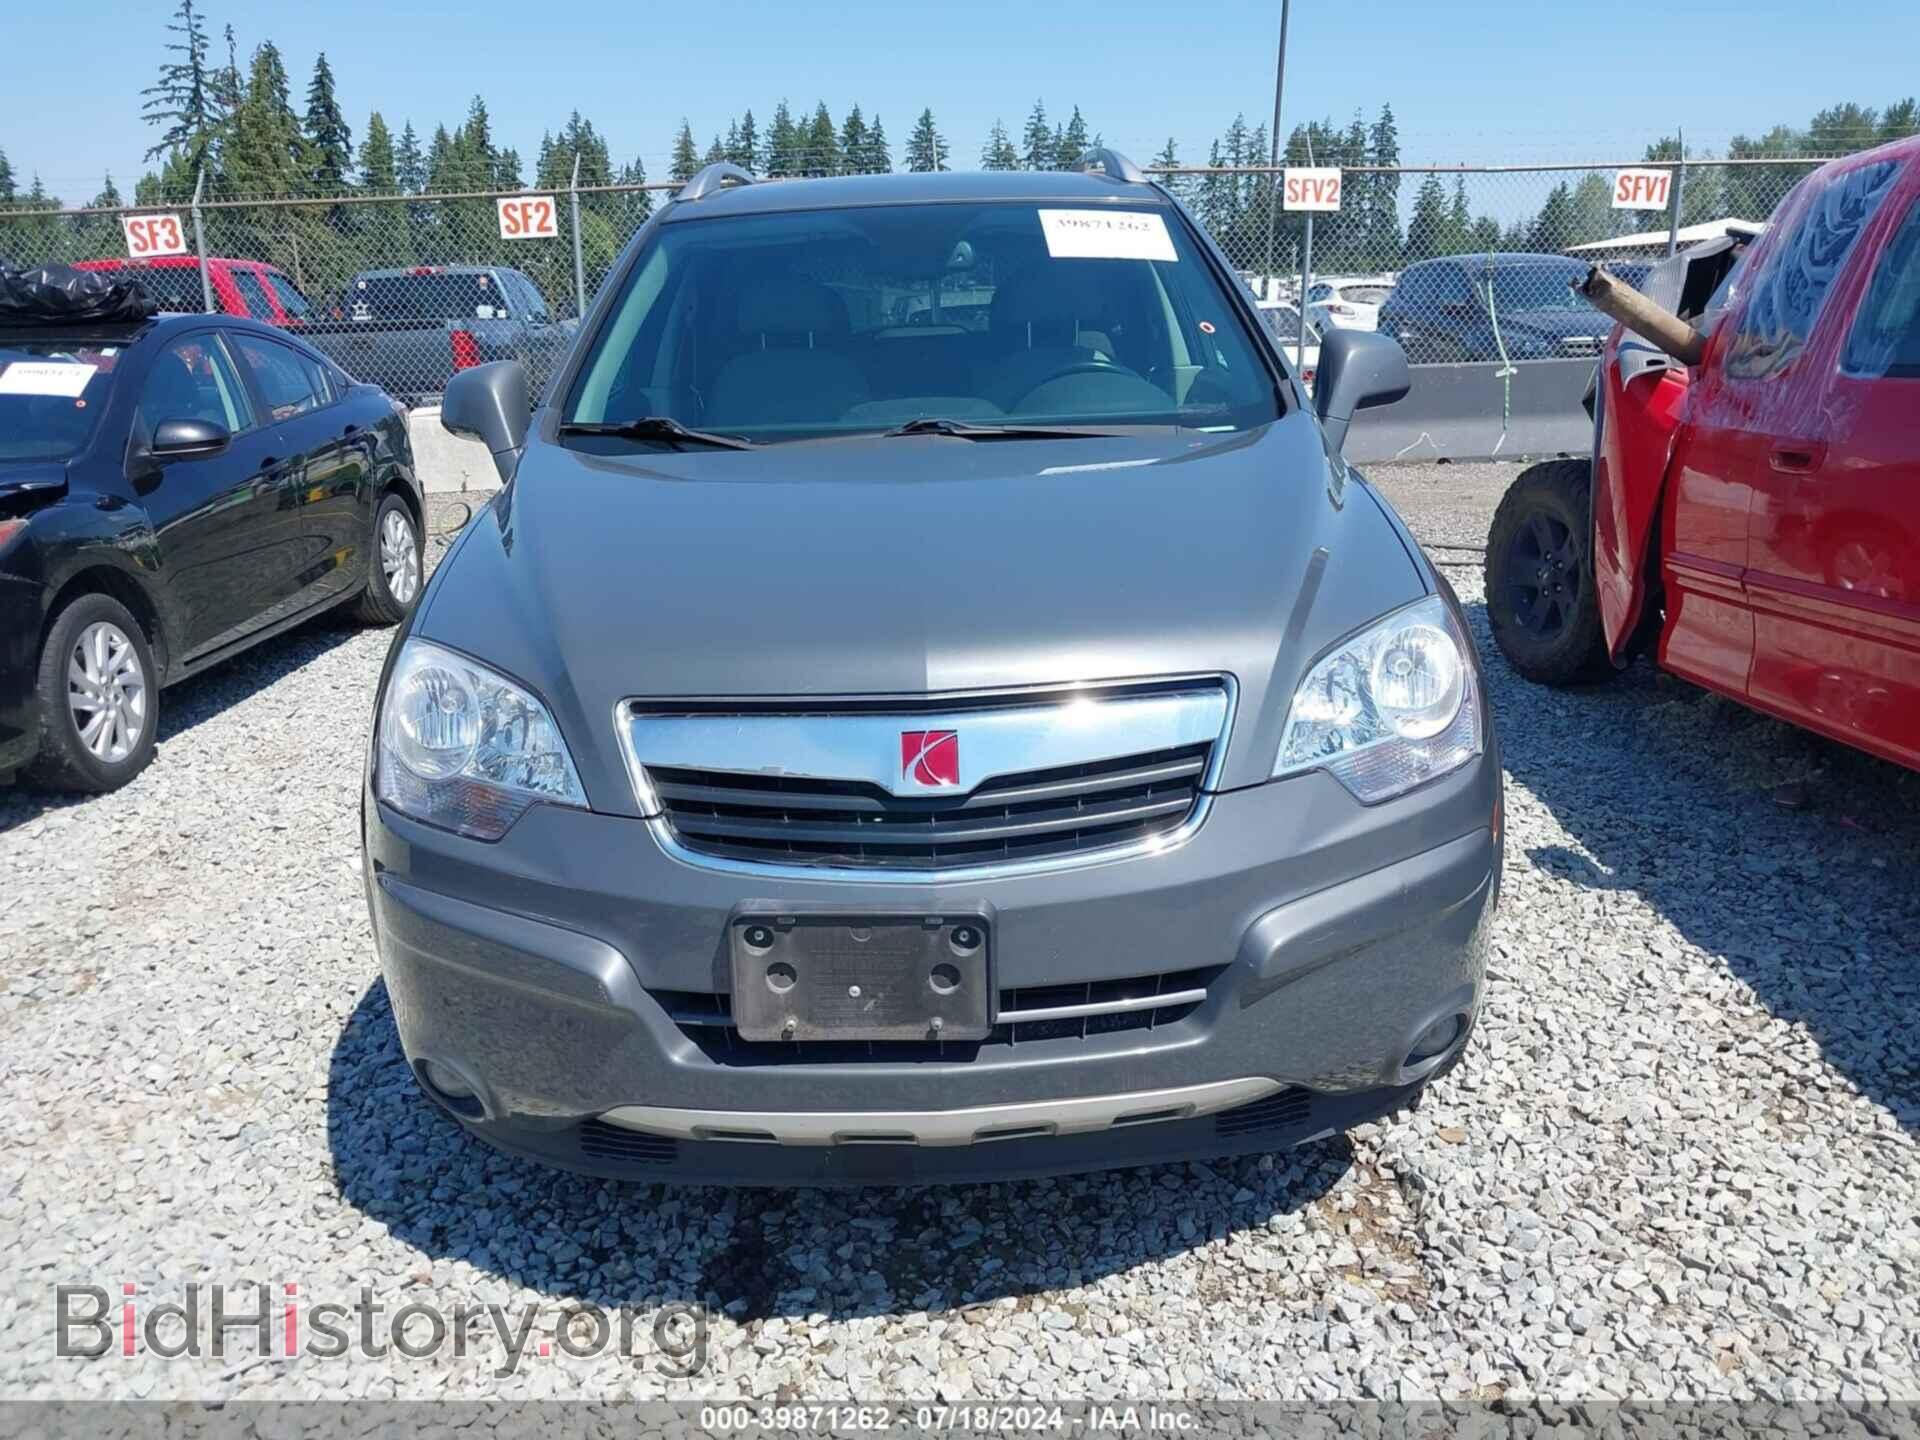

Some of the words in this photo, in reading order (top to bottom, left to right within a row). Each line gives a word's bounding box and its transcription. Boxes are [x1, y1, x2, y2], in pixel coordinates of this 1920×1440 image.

[1287, 178, 1339, 203] SFV2
[1617, 175, 1668, 202] SFV1
[502, 201, 552, 234] SF2
[129, 218, 180, 252] SF3
